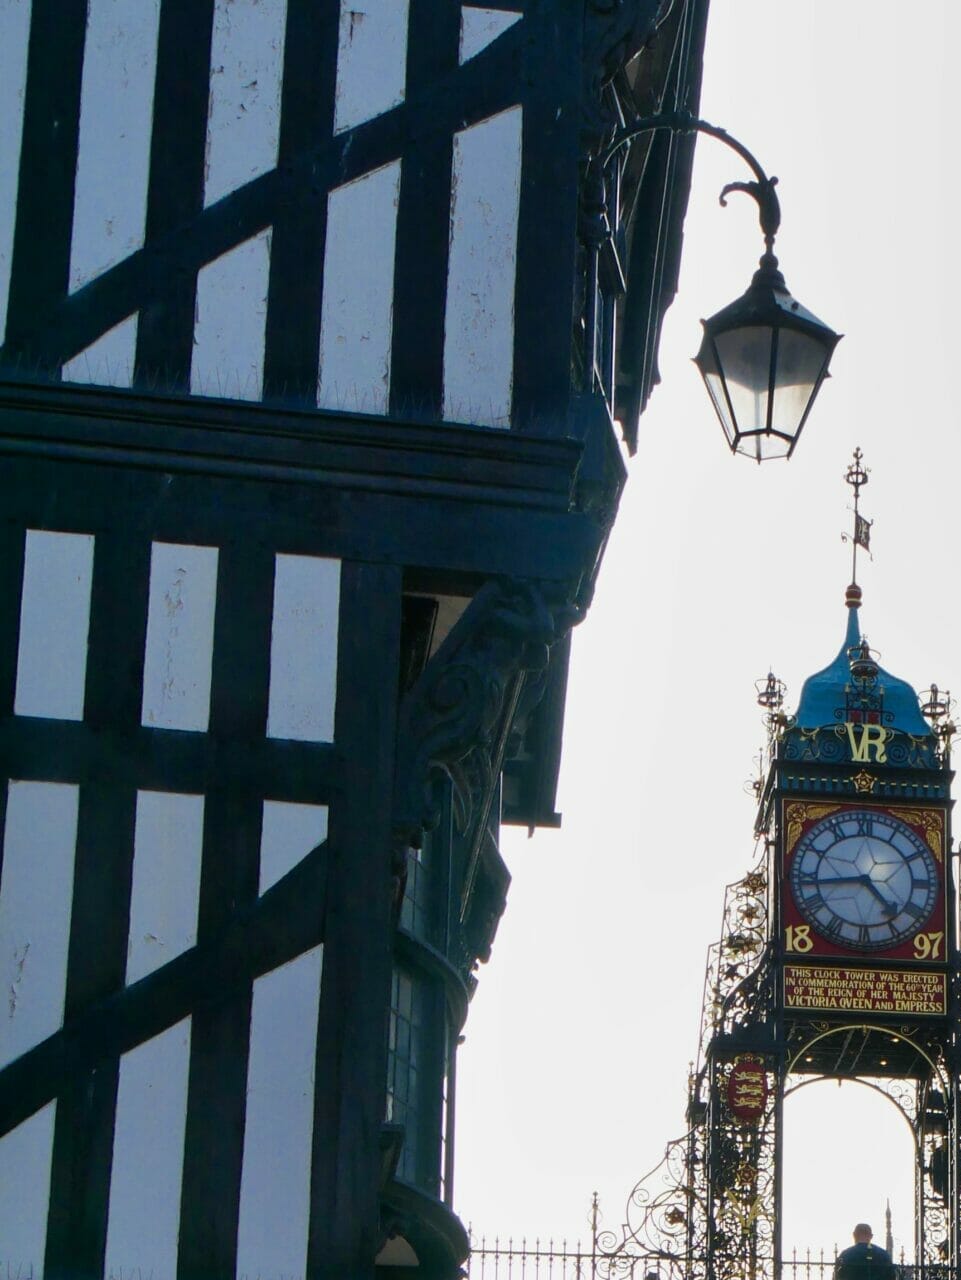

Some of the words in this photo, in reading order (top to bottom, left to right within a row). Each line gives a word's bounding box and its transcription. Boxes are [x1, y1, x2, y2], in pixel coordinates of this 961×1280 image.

[844, 722, 888, 764] VR
[784, 924, 814, 953] 18
[913, 931, 944, 959] 97
[790, 969, 811, 978] THIS
[814, 970, 840, 979] CLOCK
[846, 972, 875, 981] TOWER
[880, 973, 899, 982] WAS
[903, 974, 939, 984] ERECTED
[785, 977, 795, 986] IN
[799, 978, 873, 990] COMMEMORATION
[876, 981, 887, 990] OF
[889, 982, 905, 991] THE
[921, 984, 943, 993] YEAR
[793, 987, 805, 995] OF
[808, 987, 824, 996] THE
[828, 988, 853, 997] REIGN
[856, 989, 867, 998] OF
[871, 990, 888, 999] HER
[893, 991, 936, 1001] MAJESTY
[787, 995, 837, 1008] VICTORIA
[839, 998, 872, 1010] QVEEN
[895, 1000, 943, 1012] EMPRESS
